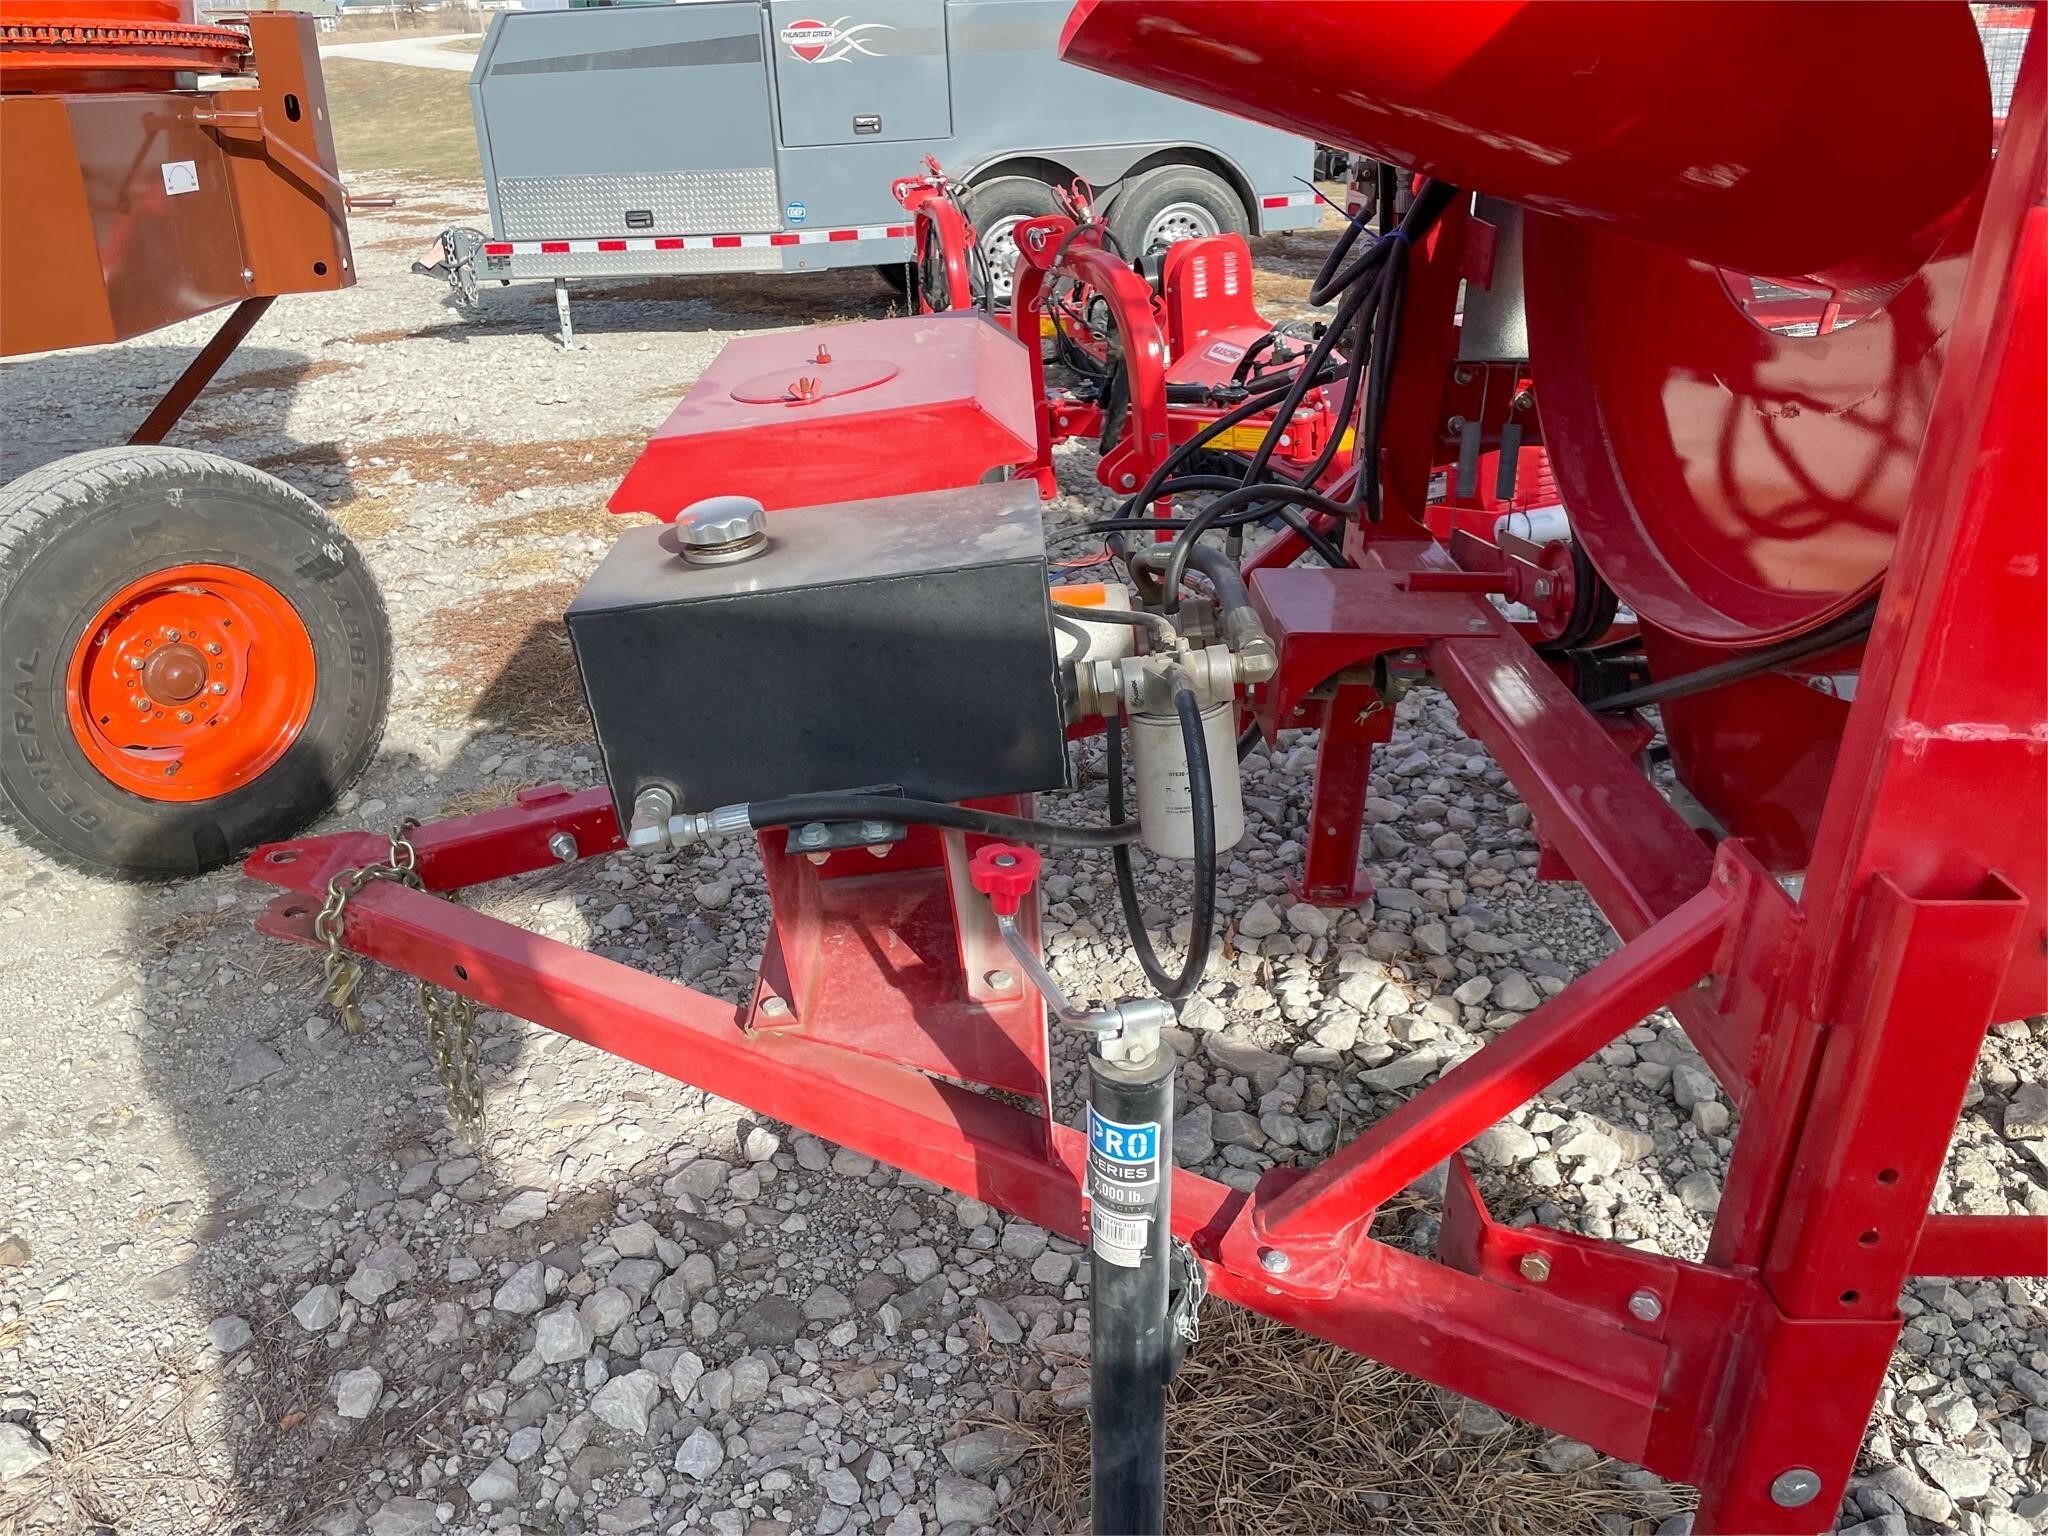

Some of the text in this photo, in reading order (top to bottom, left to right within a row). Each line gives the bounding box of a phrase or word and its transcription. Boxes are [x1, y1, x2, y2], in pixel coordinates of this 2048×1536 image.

[782, 30, 833, 39] THUNDER CREEK
[13, 649, 105, 833] GENERAL
[1092, 1117, 1148, 1160] PRO
[1092, 1151, 1148, 1179] SERIES
[1094, 1176, 1145, 1203] 2,000 lb.
